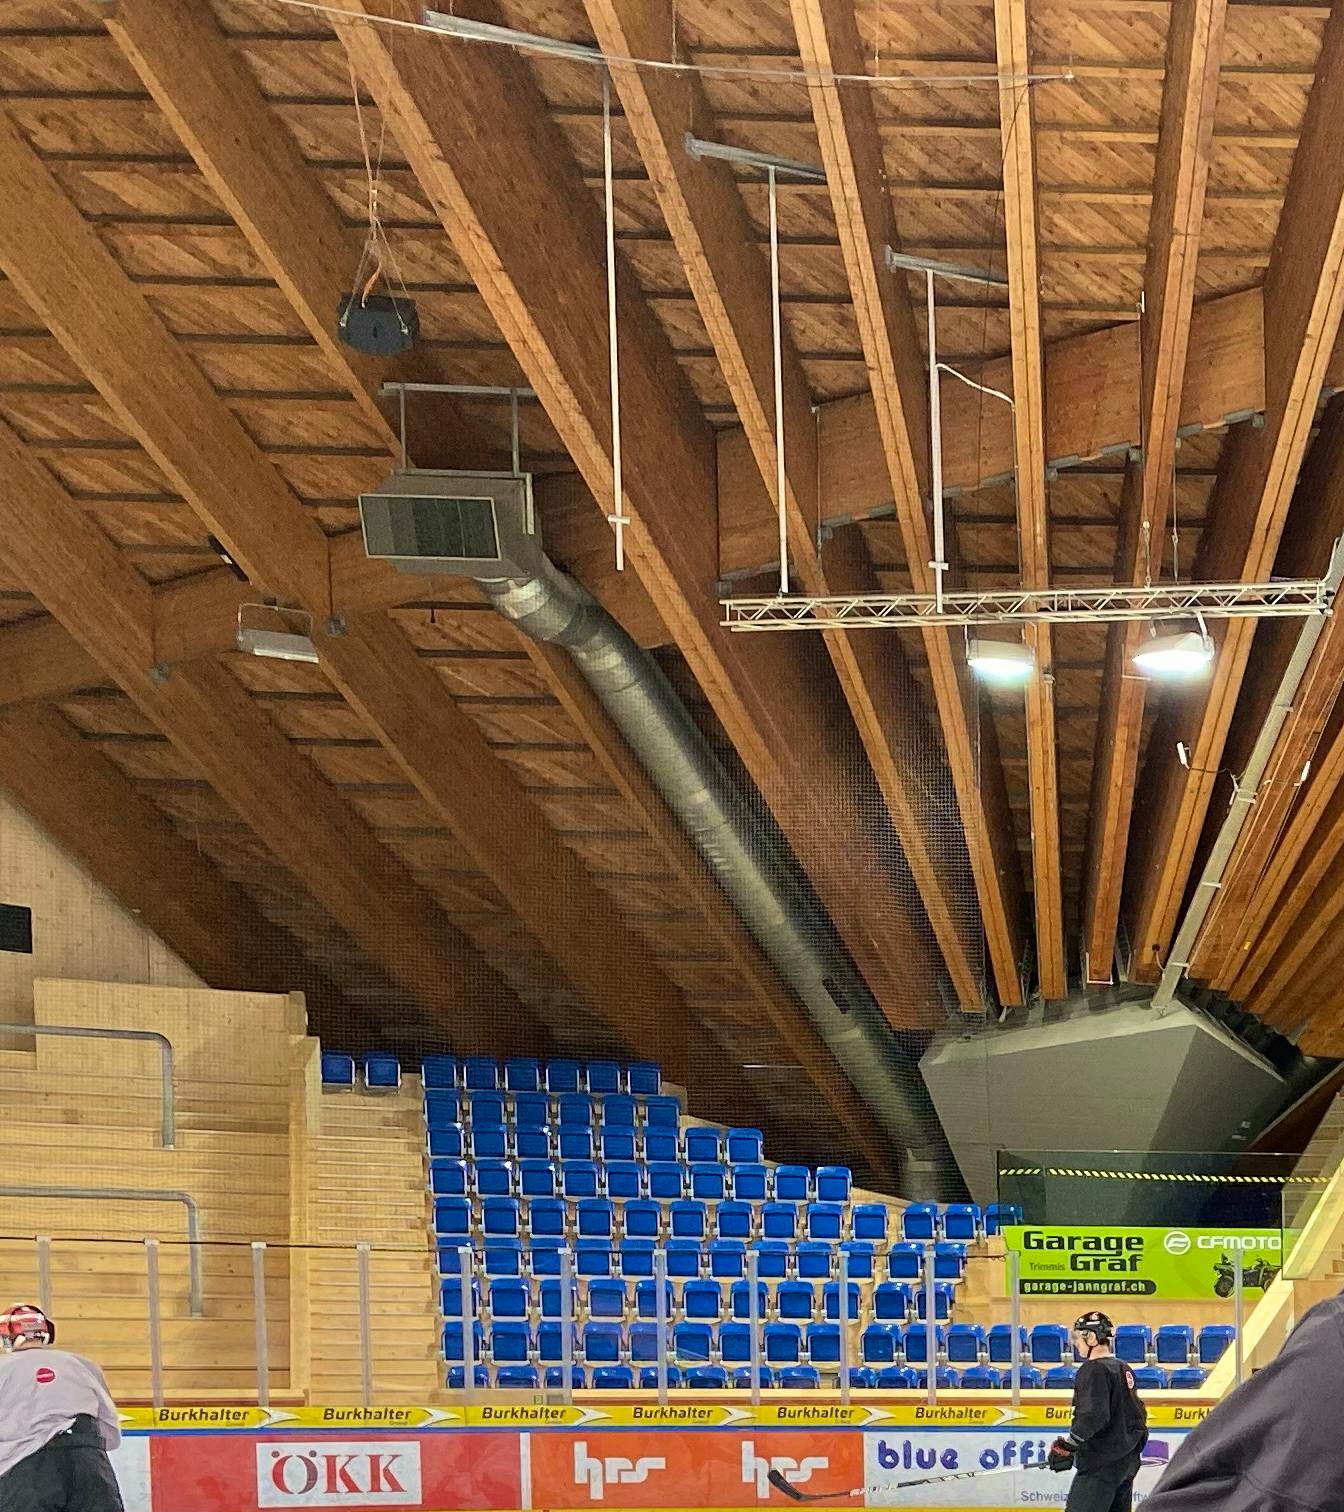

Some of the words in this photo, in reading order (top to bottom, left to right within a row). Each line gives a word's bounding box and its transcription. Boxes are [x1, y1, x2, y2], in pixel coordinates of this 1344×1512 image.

[1023, 1230, 1144, 1256] Garage
[1197, 1235, 1281, 1250] CFMOTO
[1029, 1263, 1065, 1272] Trimmis
[1070, 1253, 1143, 1273] Graf
[1024, 1281, 1146, 1294] garage-janngraf.ch
[159, 1409, 250, 1422] Burkhalter
[323, 1408, 412, 1420] Burkhalter
[481, 1407, 566, 1420] Burkhalter
[633, 1407, 713, 1419] Burkhalter
[777, 1407, 855, 1419] Burkhalter
[915, 1407, 987, 1419] Burkhalter
[877, 1439, 959, 1470] blue
[270, 1450, 407, 1495] ÖKK
